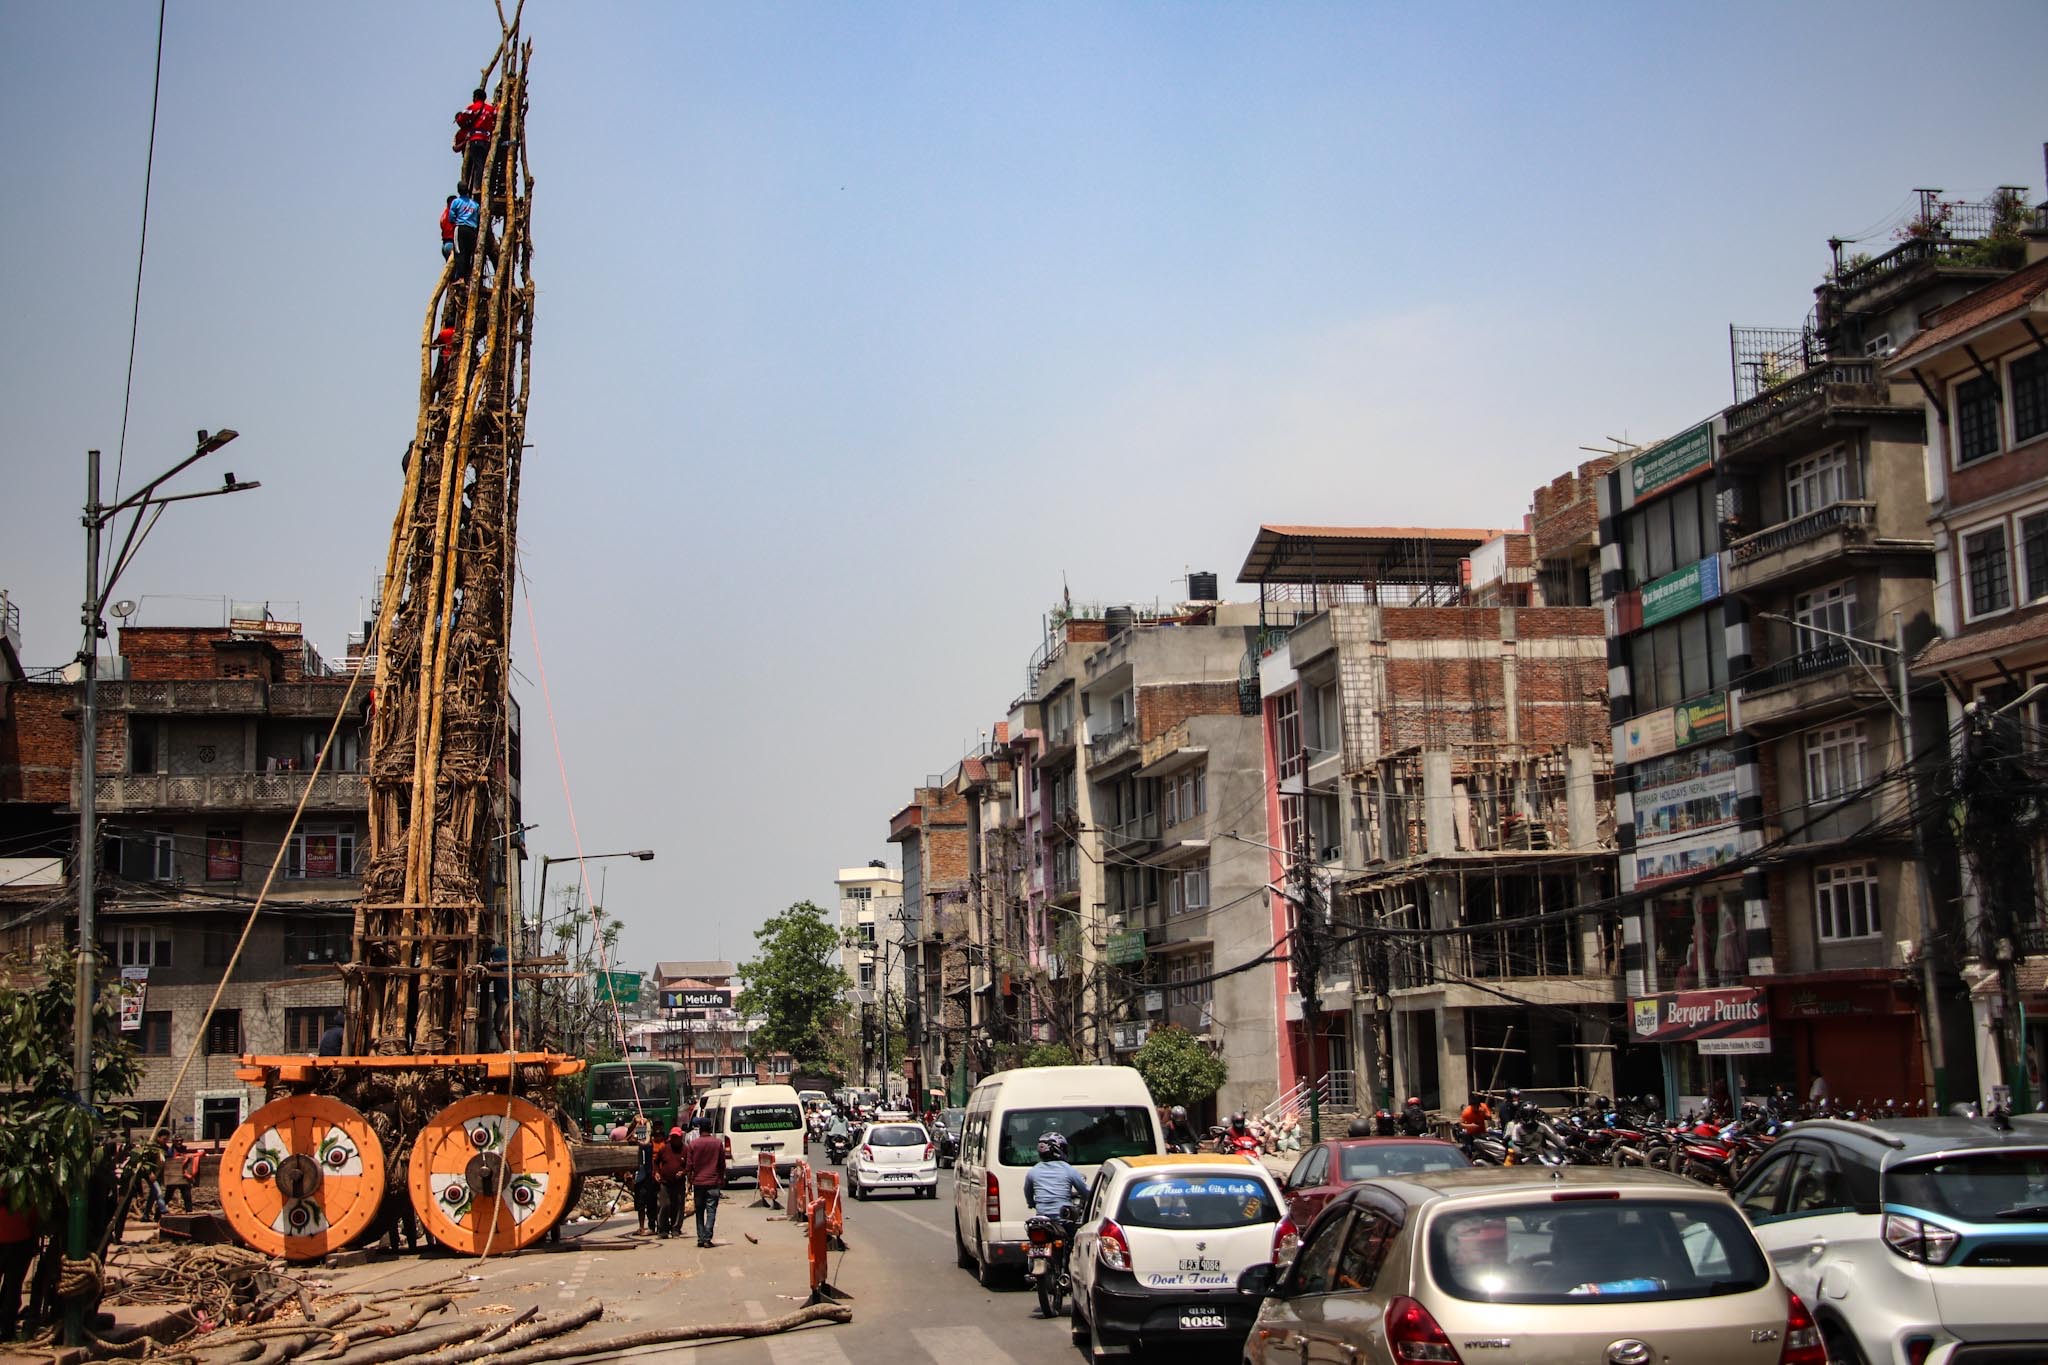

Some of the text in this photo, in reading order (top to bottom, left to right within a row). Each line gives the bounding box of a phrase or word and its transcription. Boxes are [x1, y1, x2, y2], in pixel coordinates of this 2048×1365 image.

[1659, 785, 1687, 800] HOLIDAYS
[1688, 781, 1706, 794] NEPAL
[685, 994, 723, 1004] MetLife
[1667, 997, 1759, 1028] Berger Paints
[1636, 1014, 1656, 1029] Berger
[1164, 1184, 1245, 1194] New Alto City Cab
[1243, 1197, 1260, 1218] TAXI
[1147, 1272, 1228, 1285] Don't Touch
